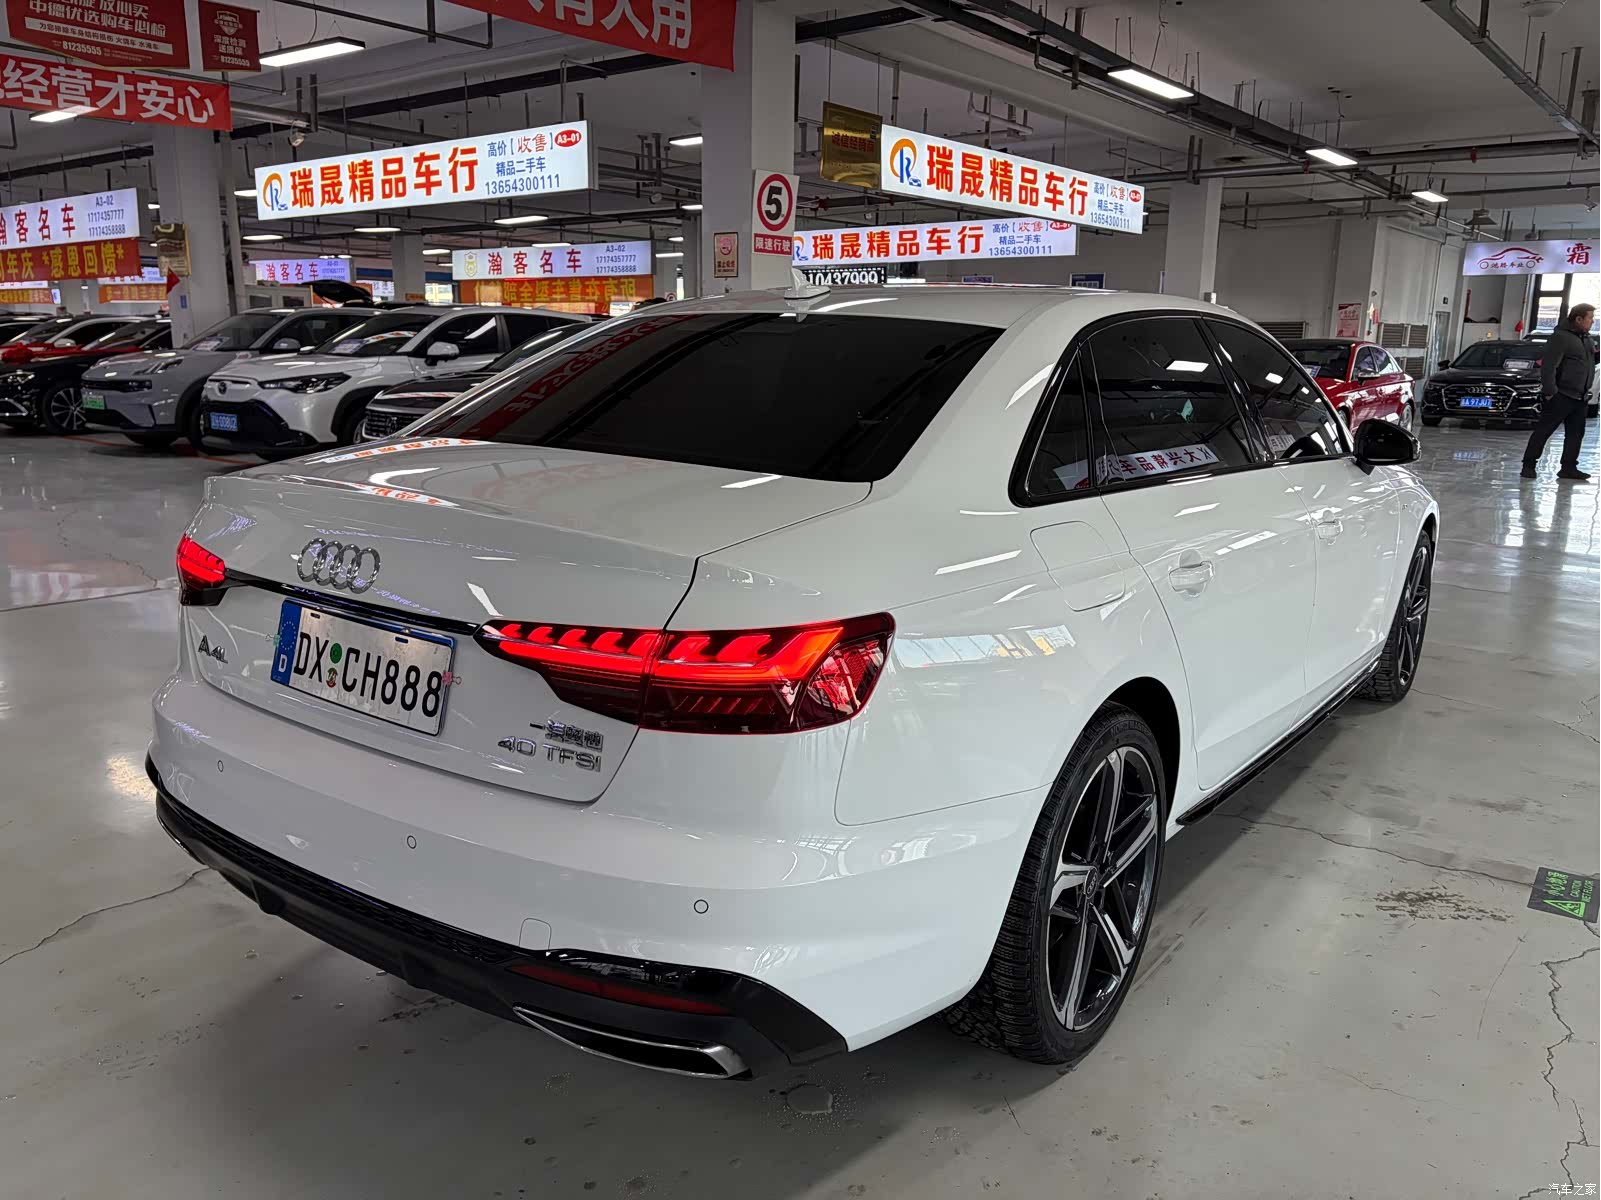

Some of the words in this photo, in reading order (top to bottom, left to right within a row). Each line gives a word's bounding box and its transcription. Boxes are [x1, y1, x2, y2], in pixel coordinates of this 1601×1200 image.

[62, 40, 102, 56] 81235555
[0, 58, 215, 124] 经营才安心
[557, 132, 580, 144] A3-01
[496, 156, 547, 177] 精品二手车
[289, 146, 479, 209] 瑞晟精品车行
[485, 173, 560, 195] 13654300111
[926, 143, 1089, 217] 瑞晟精品车行
[95, 195, 114, 206] A3-02
[764, 185, 783, 221] 5
[87, 209, 124, 223] 17174357777
[1051, 220, 1071, 229] A3-01
[1090, 211, 1130, 229] 13654300111
[88, 223, 126, 237] 17174358888
[755, 236, 791, 253] 限速行驶
[811, 226, 984, 260] 瑞晟精品车行
[999, 234, 1042, 245] 精品二手车
[605, 244, 626, 253] A3-02
[988, 245, 1052, 256] 13654300111
[487, 248, 583, 275] 瀚客名车
[595, 254, 637, 264] 17174357777
[595, 264, 637, 274] 17174358888
[278, 653, 288, 673] D
[293, 631, 329, 683] DX
[341, 646, 443, 718] CH888
[498, 736, 537, 757] 40
[542, 743, 601, 772] TFSI
